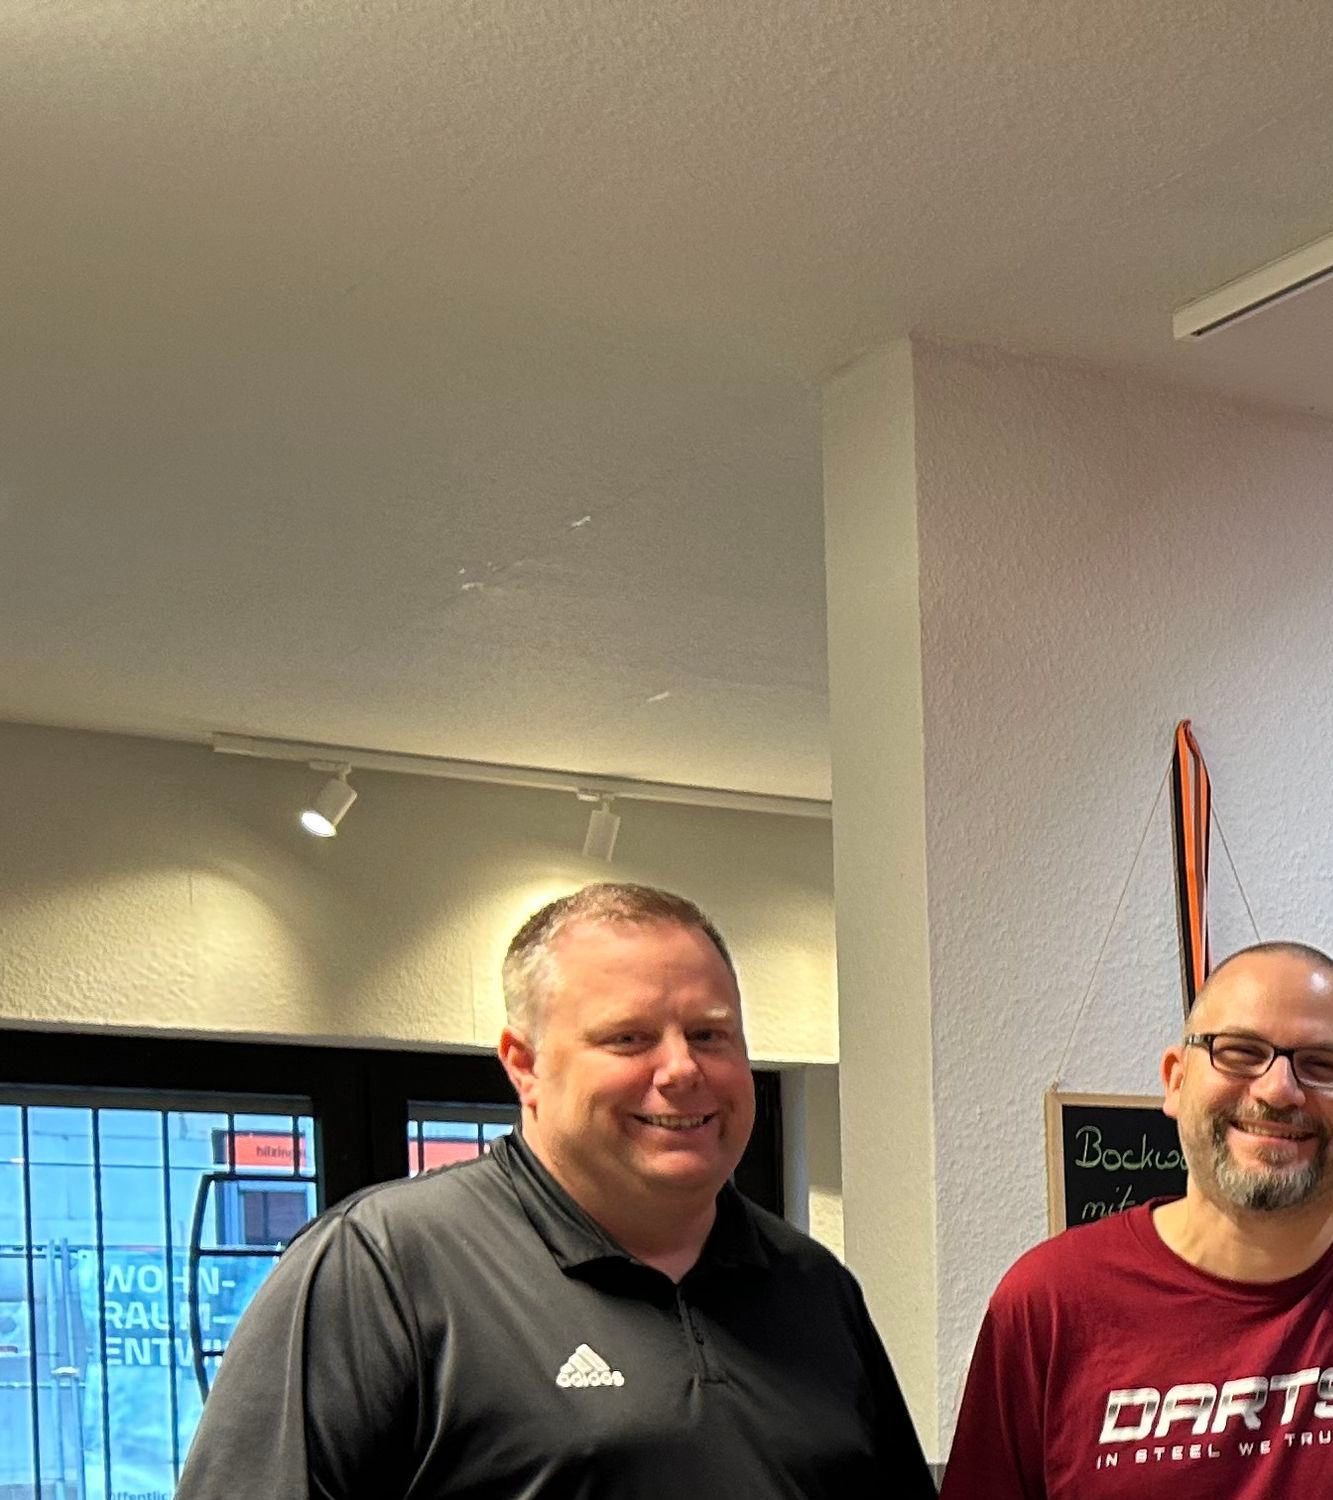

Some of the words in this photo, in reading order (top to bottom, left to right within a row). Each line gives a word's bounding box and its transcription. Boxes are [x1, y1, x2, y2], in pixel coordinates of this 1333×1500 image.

[1081, 1184, 1137, 1220] mit
[556, 1370, 625, 1388] adidas
[1096, 1452, 1118, 1470] IN
[1135, 1443, 1220, 1465] STEEL
[1239, 1439, 1271, 1457] WE
